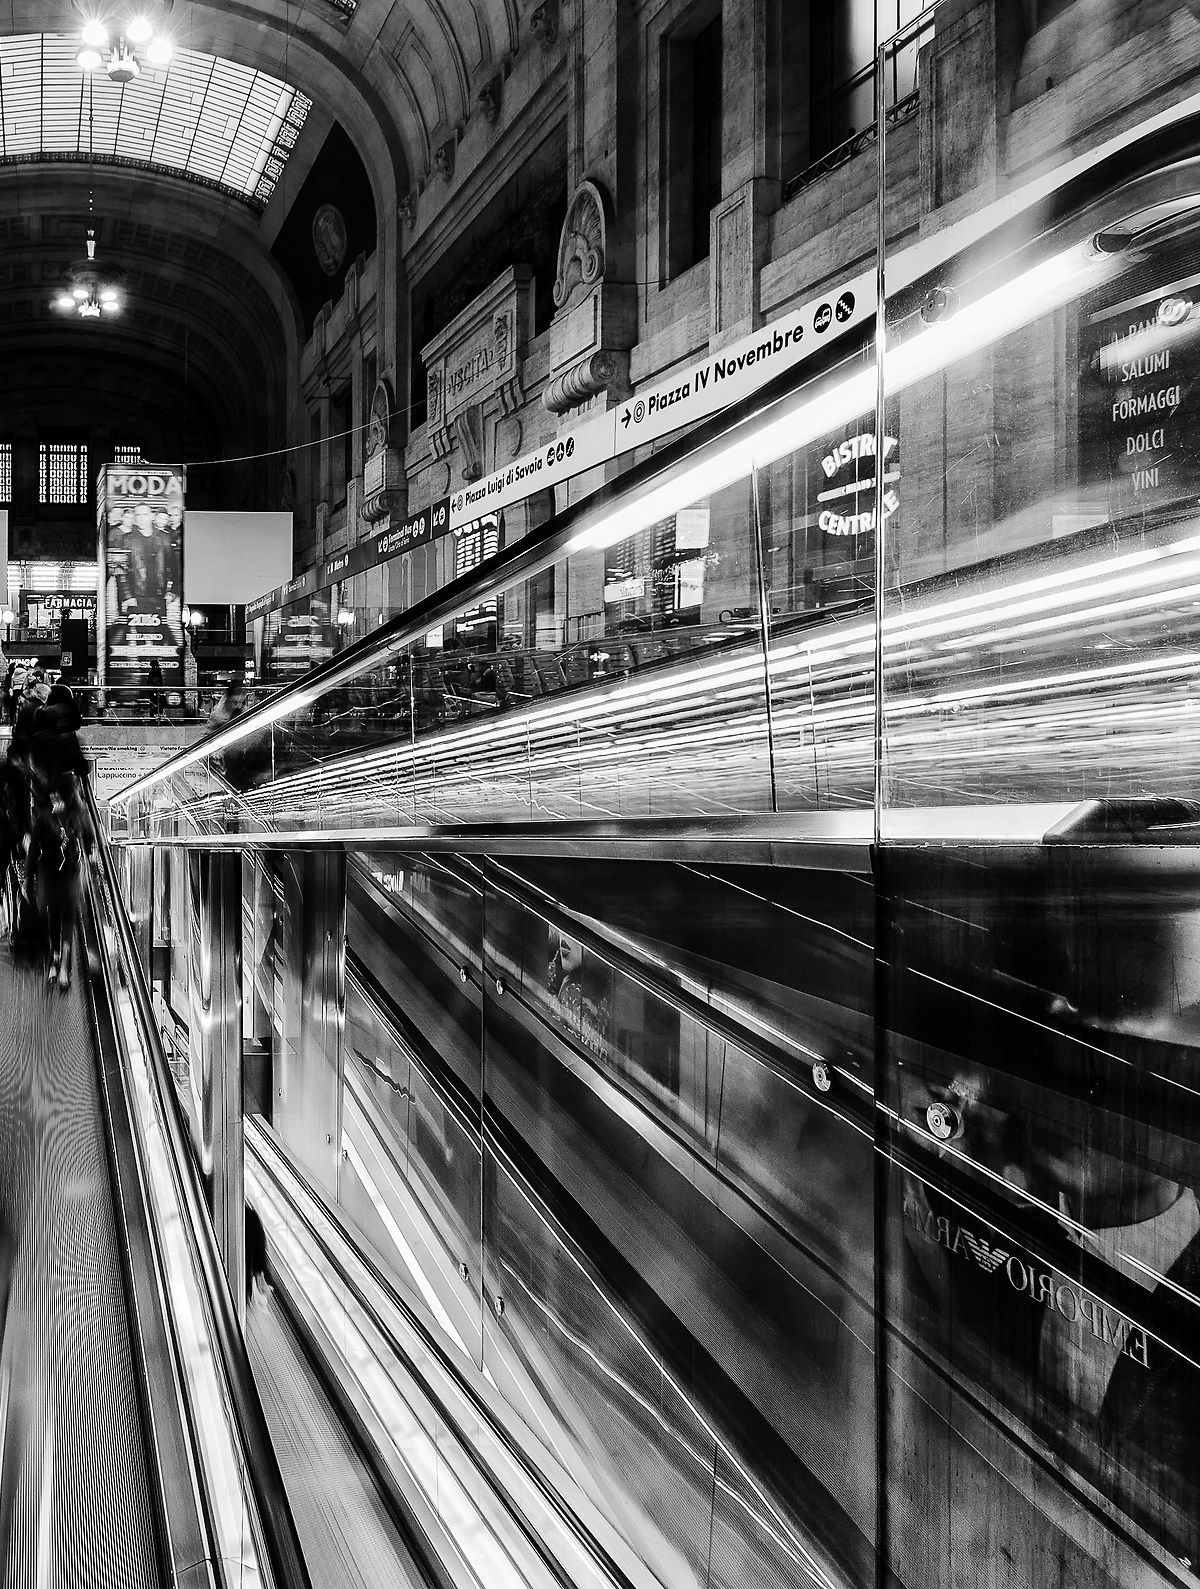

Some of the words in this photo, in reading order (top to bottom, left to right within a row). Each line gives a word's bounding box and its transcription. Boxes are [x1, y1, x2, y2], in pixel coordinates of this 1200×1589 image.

[648, 382, 691, 416] Piazza
[694, 366, 711, 393] IV
[713, 324, 805, 384] Novembre
[1121, 350, 1170, 383] SALUMI
[1112, 385, 1181, 422] FORMAGGI
[1126, 428, 1164, 456] DOLCI
[465, 488, 486, 506] Piazza
[487, 473, 505, 494] Luigi
[506, 469, 514, 486] di
[515, 456, 543, 482] Savoia
[1132, 467, 1160, 491] VINI
[45, 598, 93, 609] FARMACIA
[97, 772, 137, 780] Cappuccino
